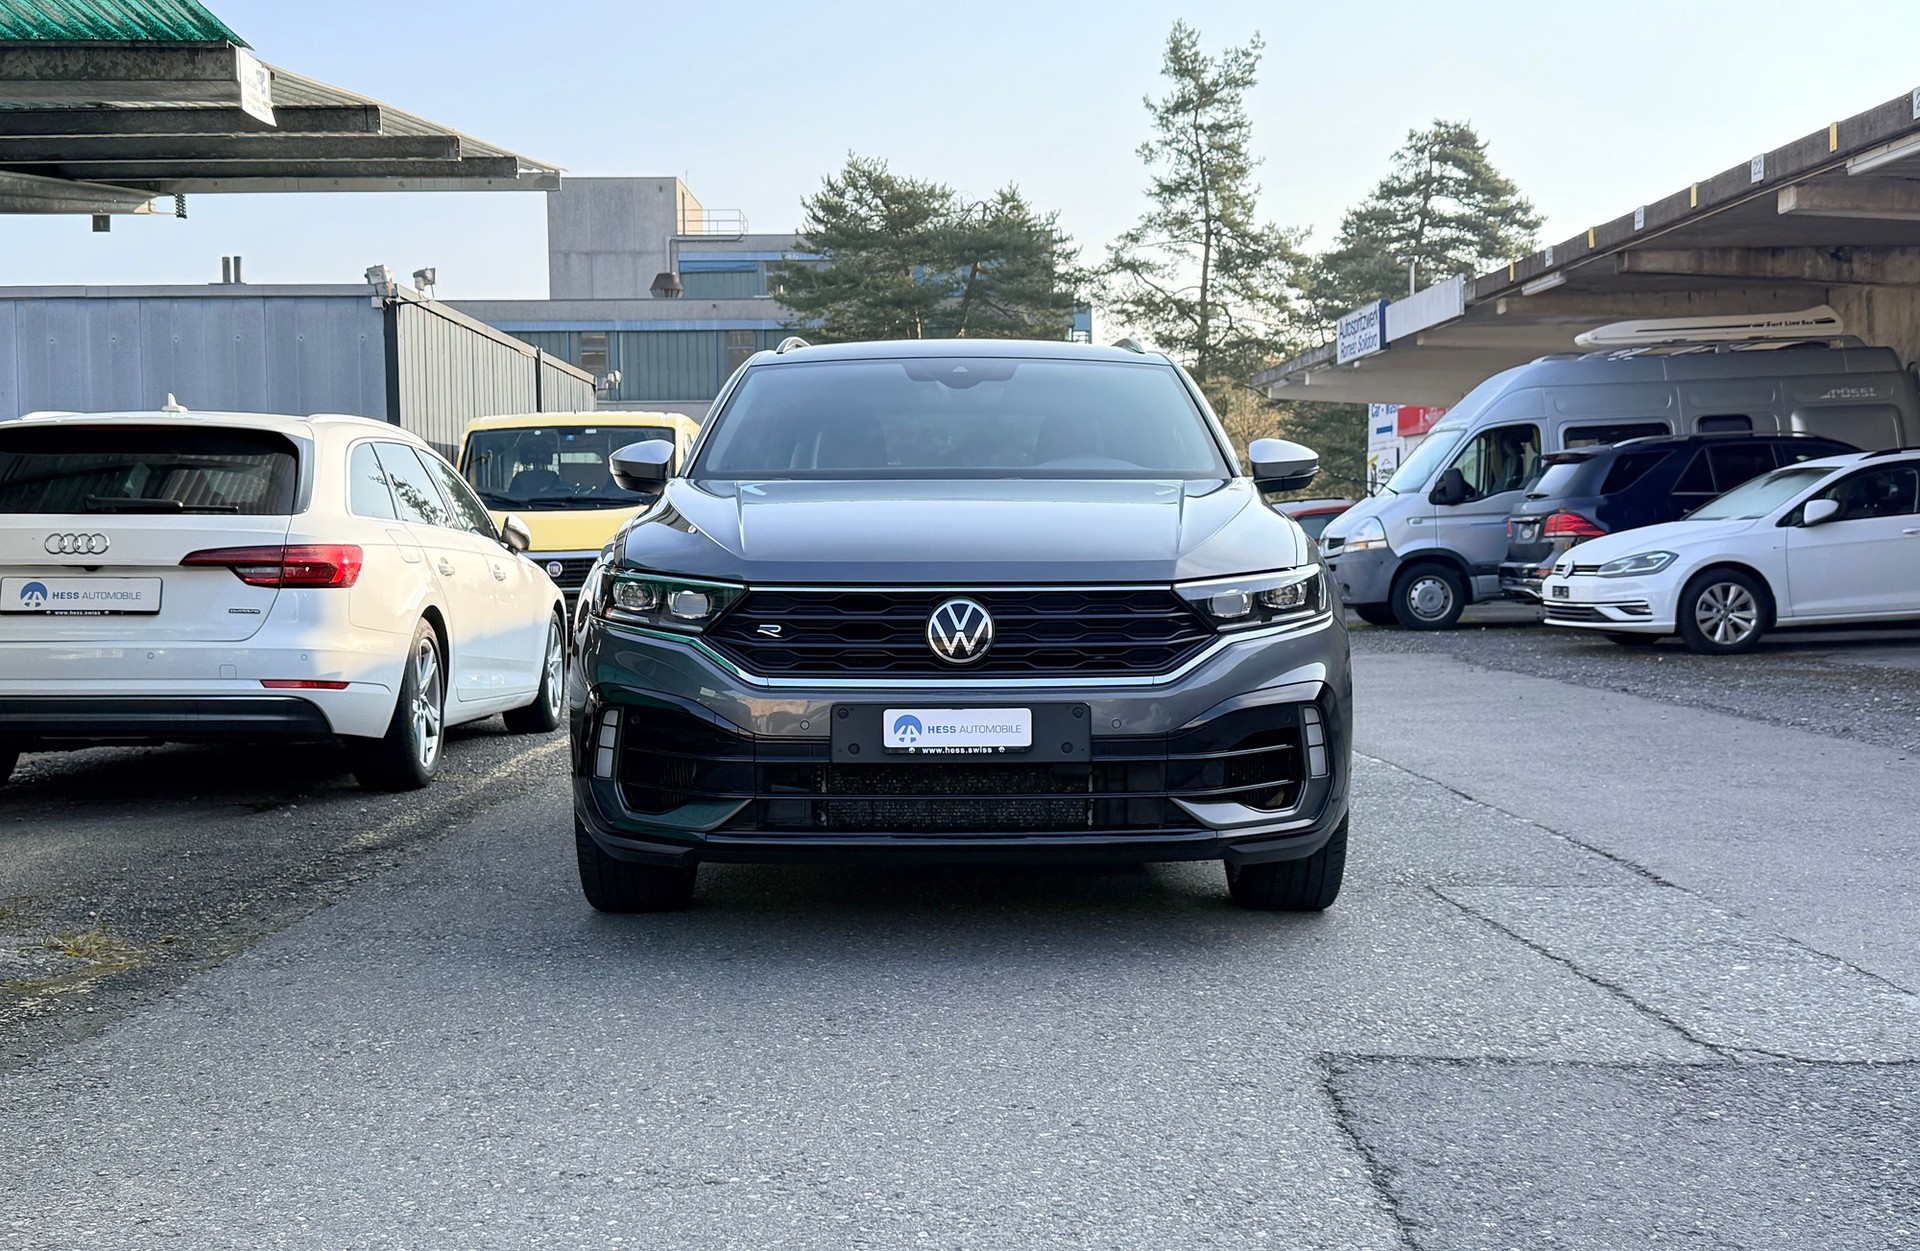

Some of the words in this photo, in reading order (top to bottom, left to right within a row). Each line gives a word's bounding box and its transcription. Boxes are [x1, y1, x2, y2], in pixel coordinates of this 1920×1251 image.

[52, 591, 80, 600] HESS
[82, 591, 141, 600] AUTOMOBILE
[927, 725, 957, 734] HESS
[959, 724, 1021, 734] AUTOMOBILE
[922, 746, 993, 754] www.hess.swiss
